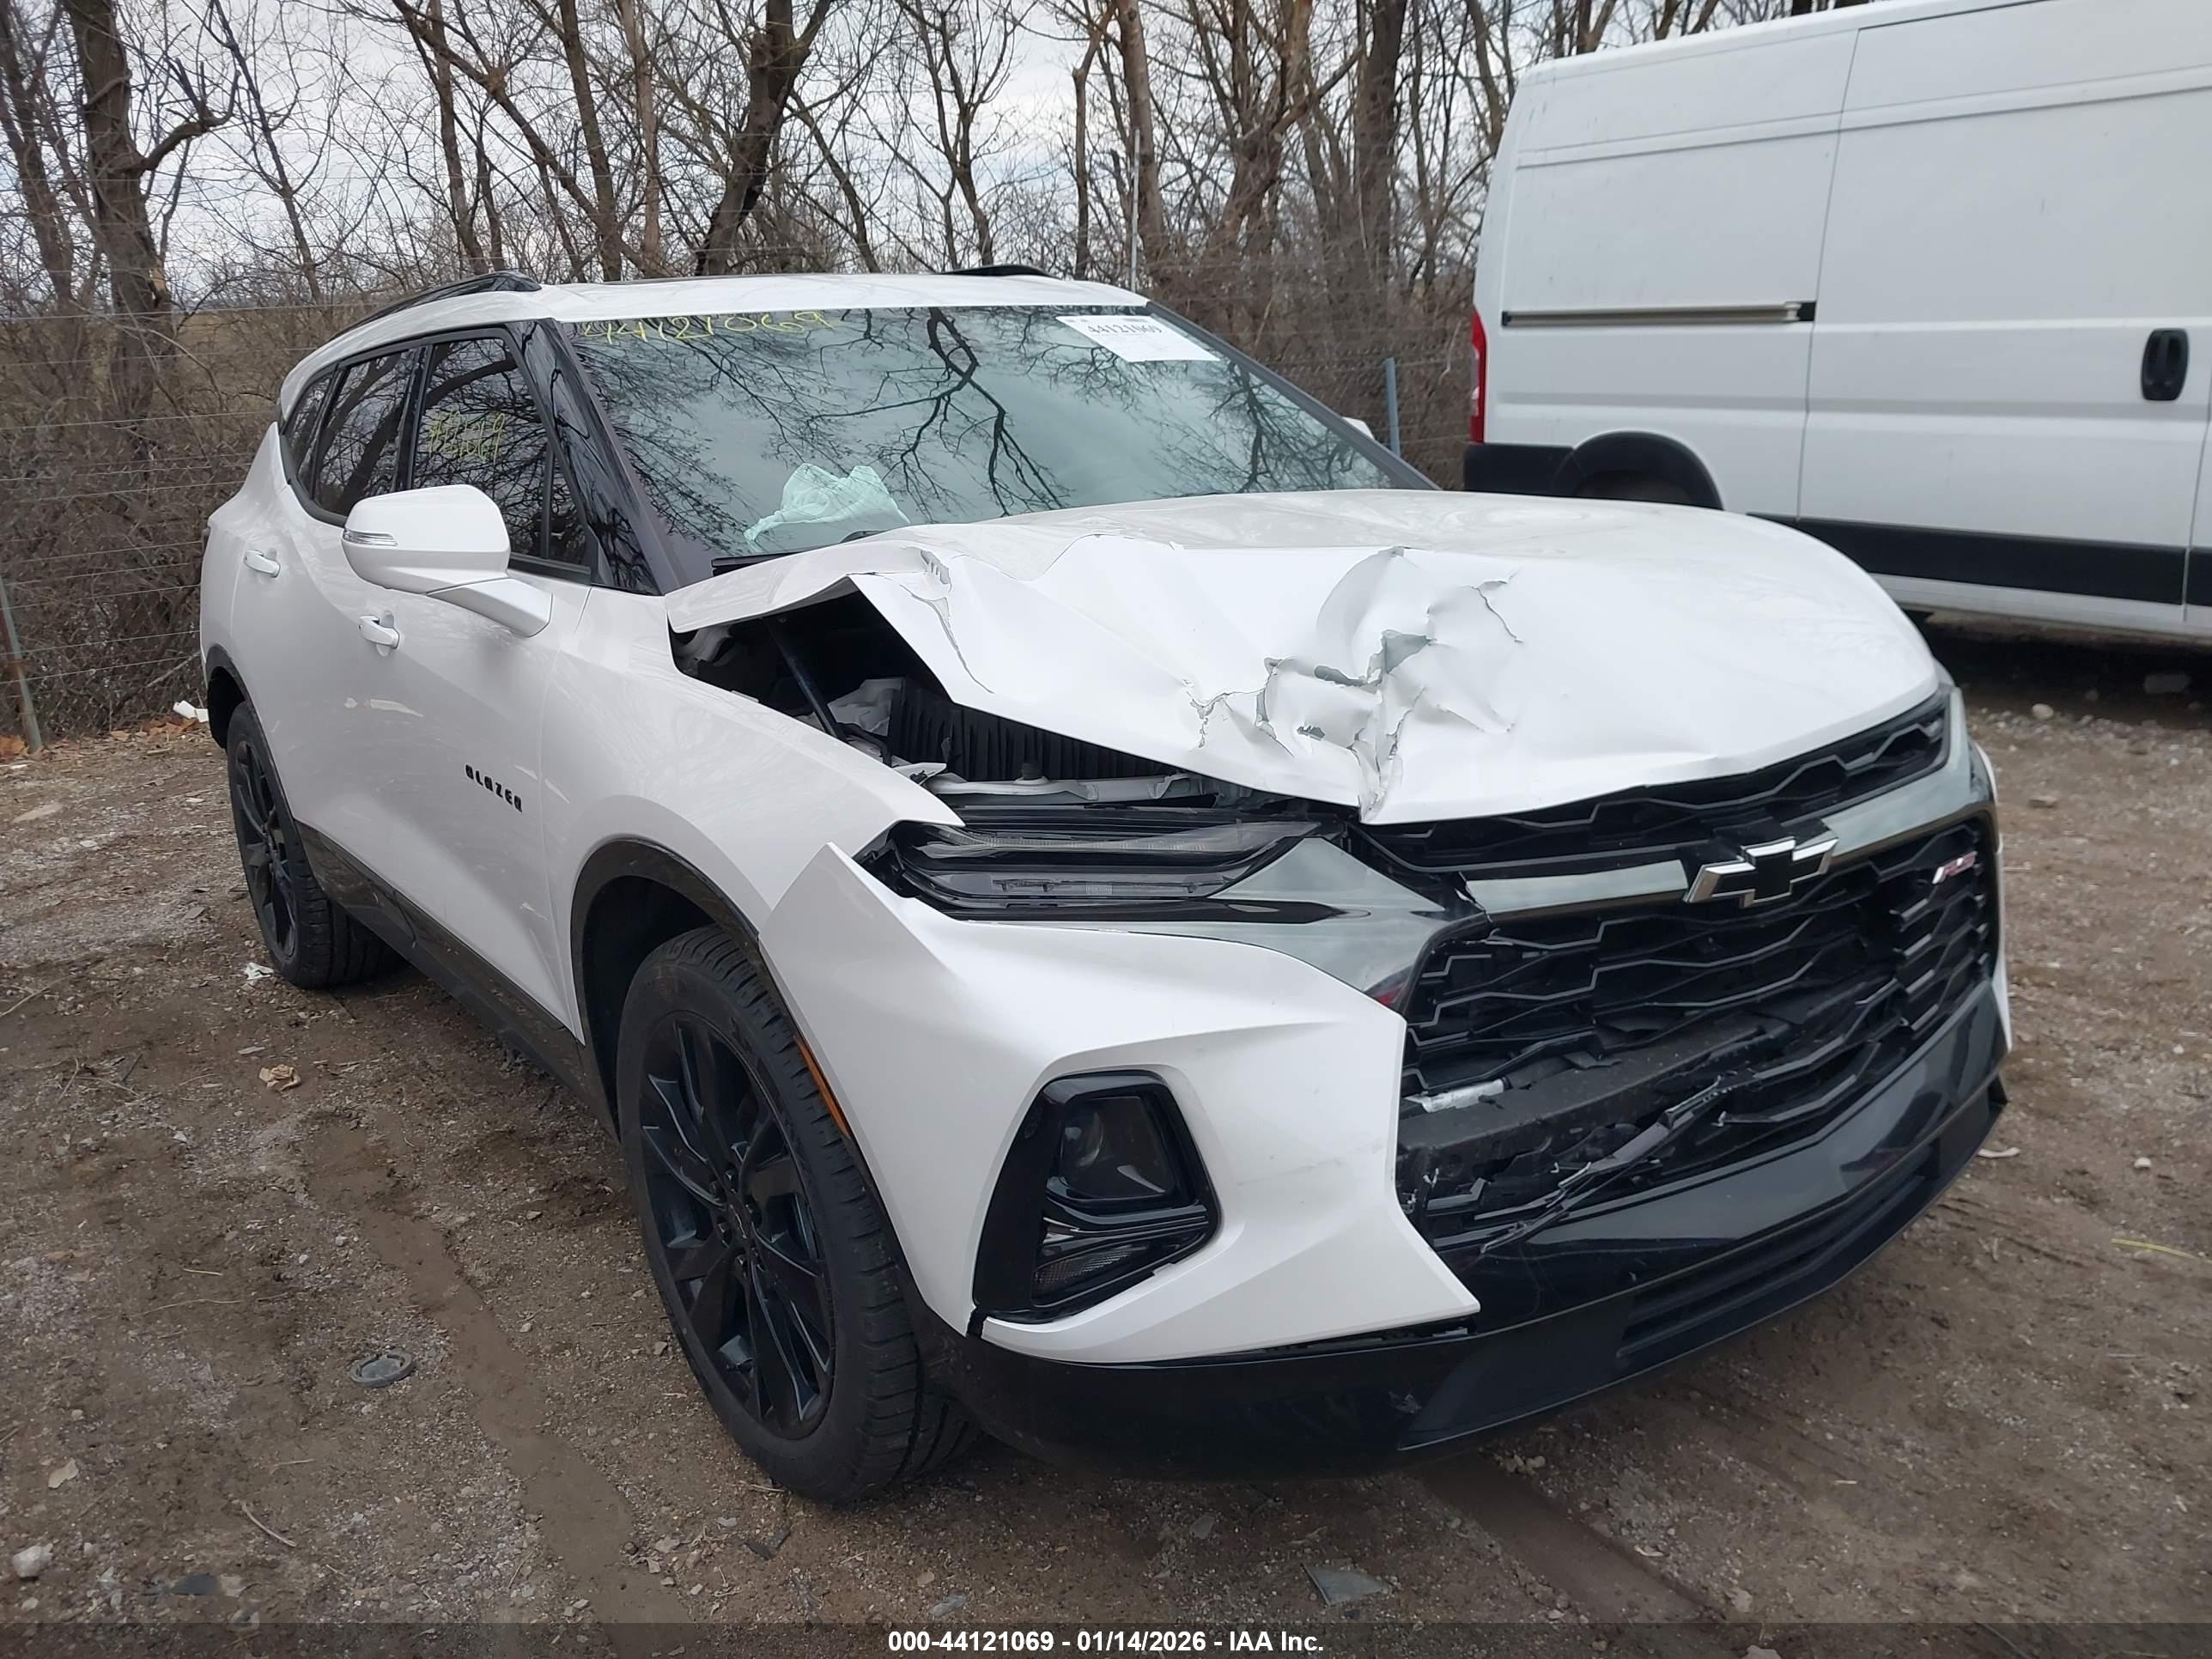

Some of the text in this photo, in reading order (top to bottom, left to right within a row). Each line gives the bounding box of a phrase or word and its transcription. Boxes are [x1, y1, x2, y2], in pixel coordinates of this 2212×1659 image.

[584, 310, 835, 343] 44121069
[465, 764, 522, 812] BLAZER
[1932, 851, 1978, 884] RS
